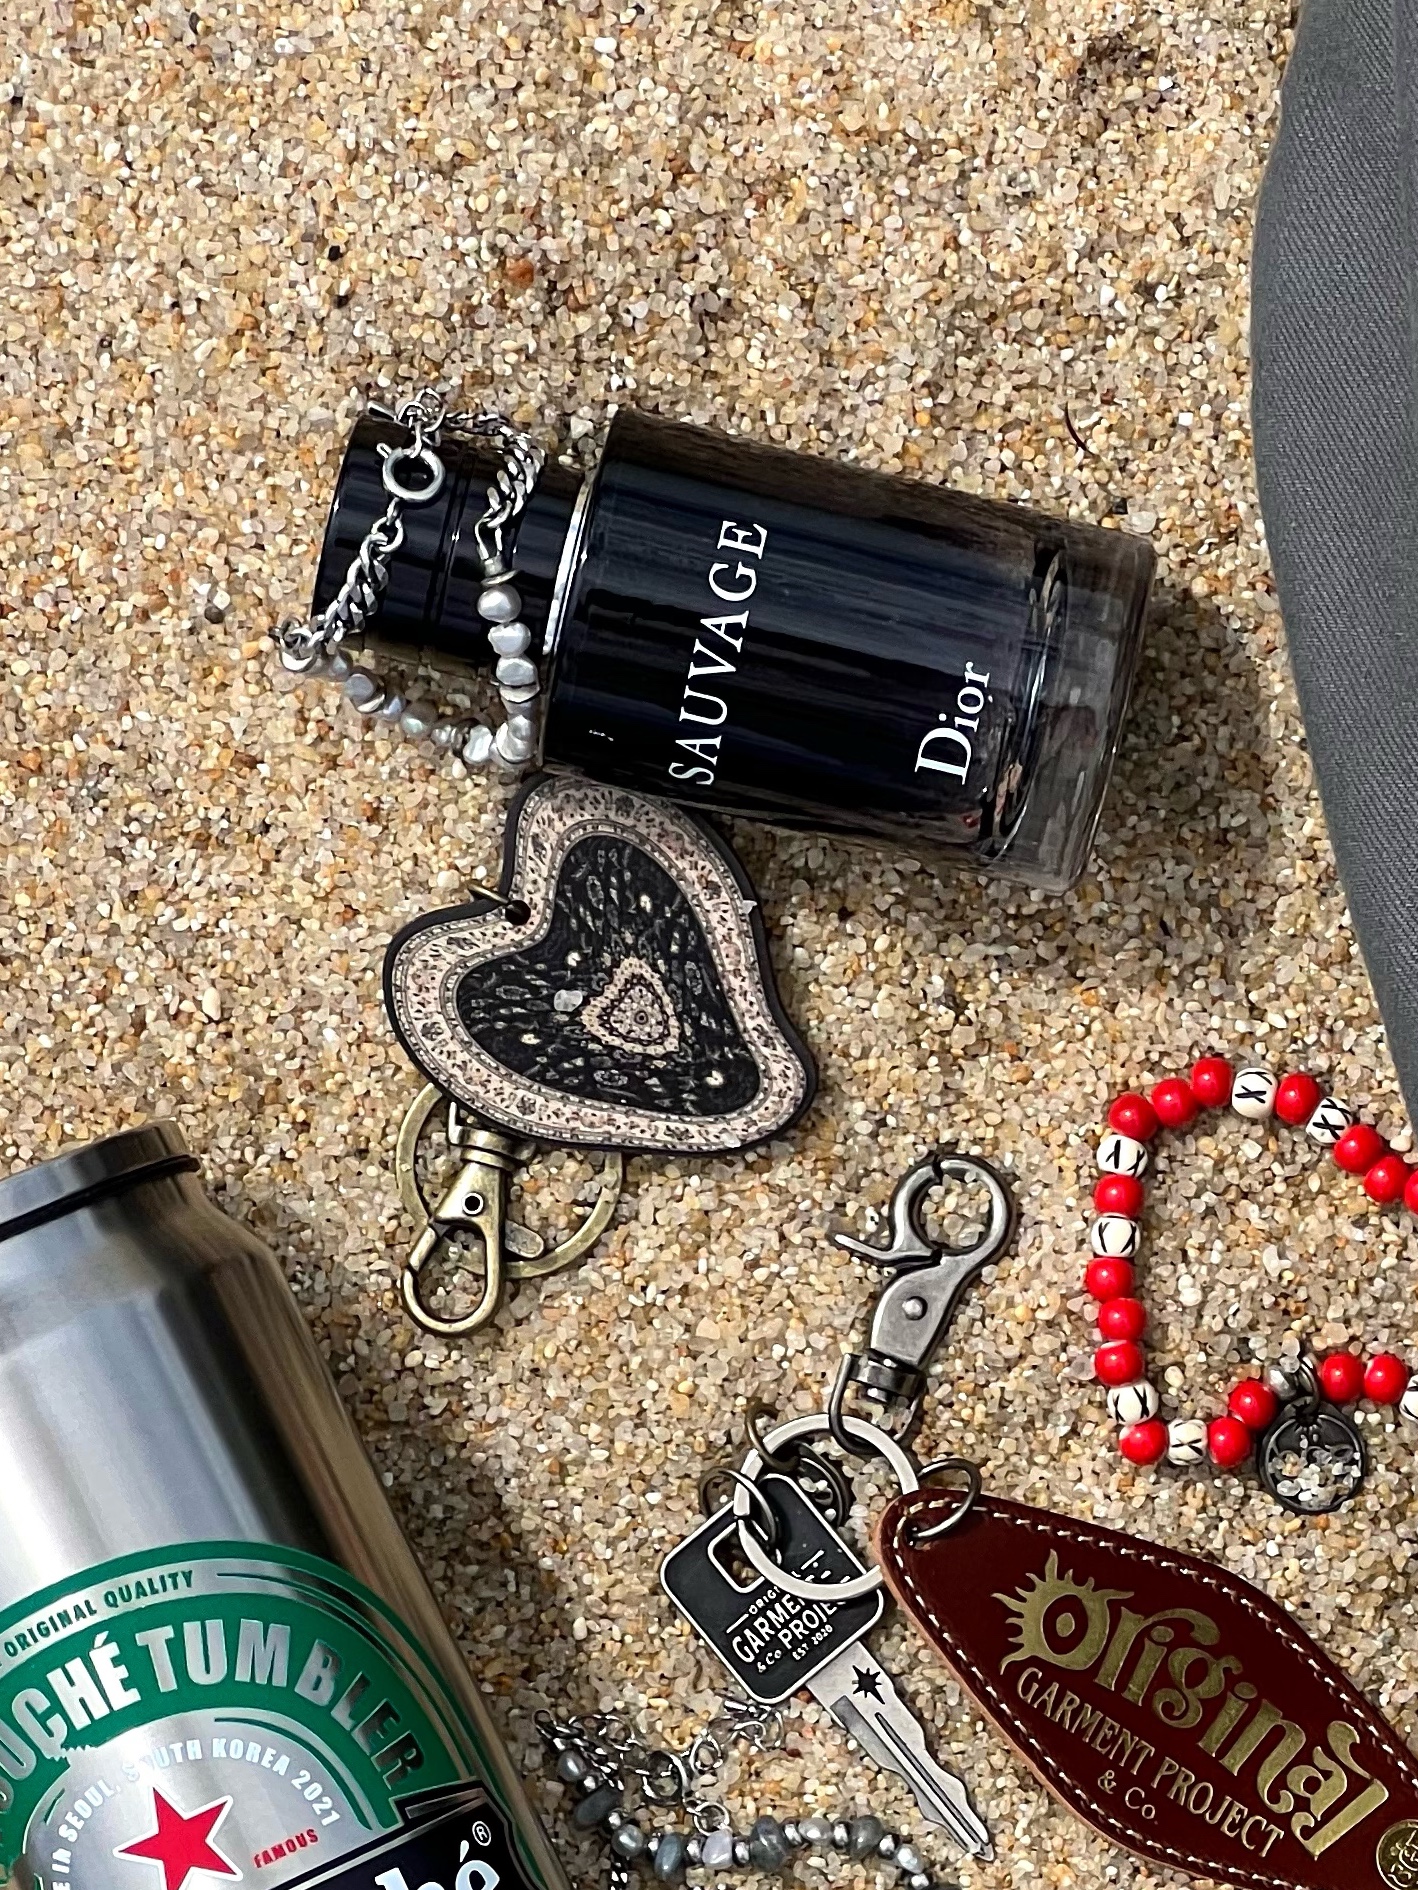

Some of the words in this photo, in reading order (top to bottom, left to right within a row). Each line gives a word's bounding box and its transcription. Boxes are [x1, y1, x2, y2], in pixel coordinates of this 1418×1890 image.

[668, 520, 769, 786] SAUVAGE
[915, 660, 991, 785] Dior
[3, 1600, 97, 1658] ORIGINAL
[103, 1570, 194, 1608] QUALITY
[731, 1590, 808, 1664] GARME
[777, 1601, 846, 1650] PROJE
[791, 1642, 810, 1661] EST
[135, 1618, 425, 1791] TUMBLER
[991, 1548, 1389, 1860] Original
[51, 1848, 72, 1874] IN
[212, 1737, 291, 1776] KOREA
[291, 1769, 341, 1827] 2021
[1016, 1666, 1156, 1776] GARMENT
[1150, 1756, 1285, 1858] PROJECT
[1096, 1769, 1118, 1794] &
[252, 1828, 319, 1869] FAMOUS
